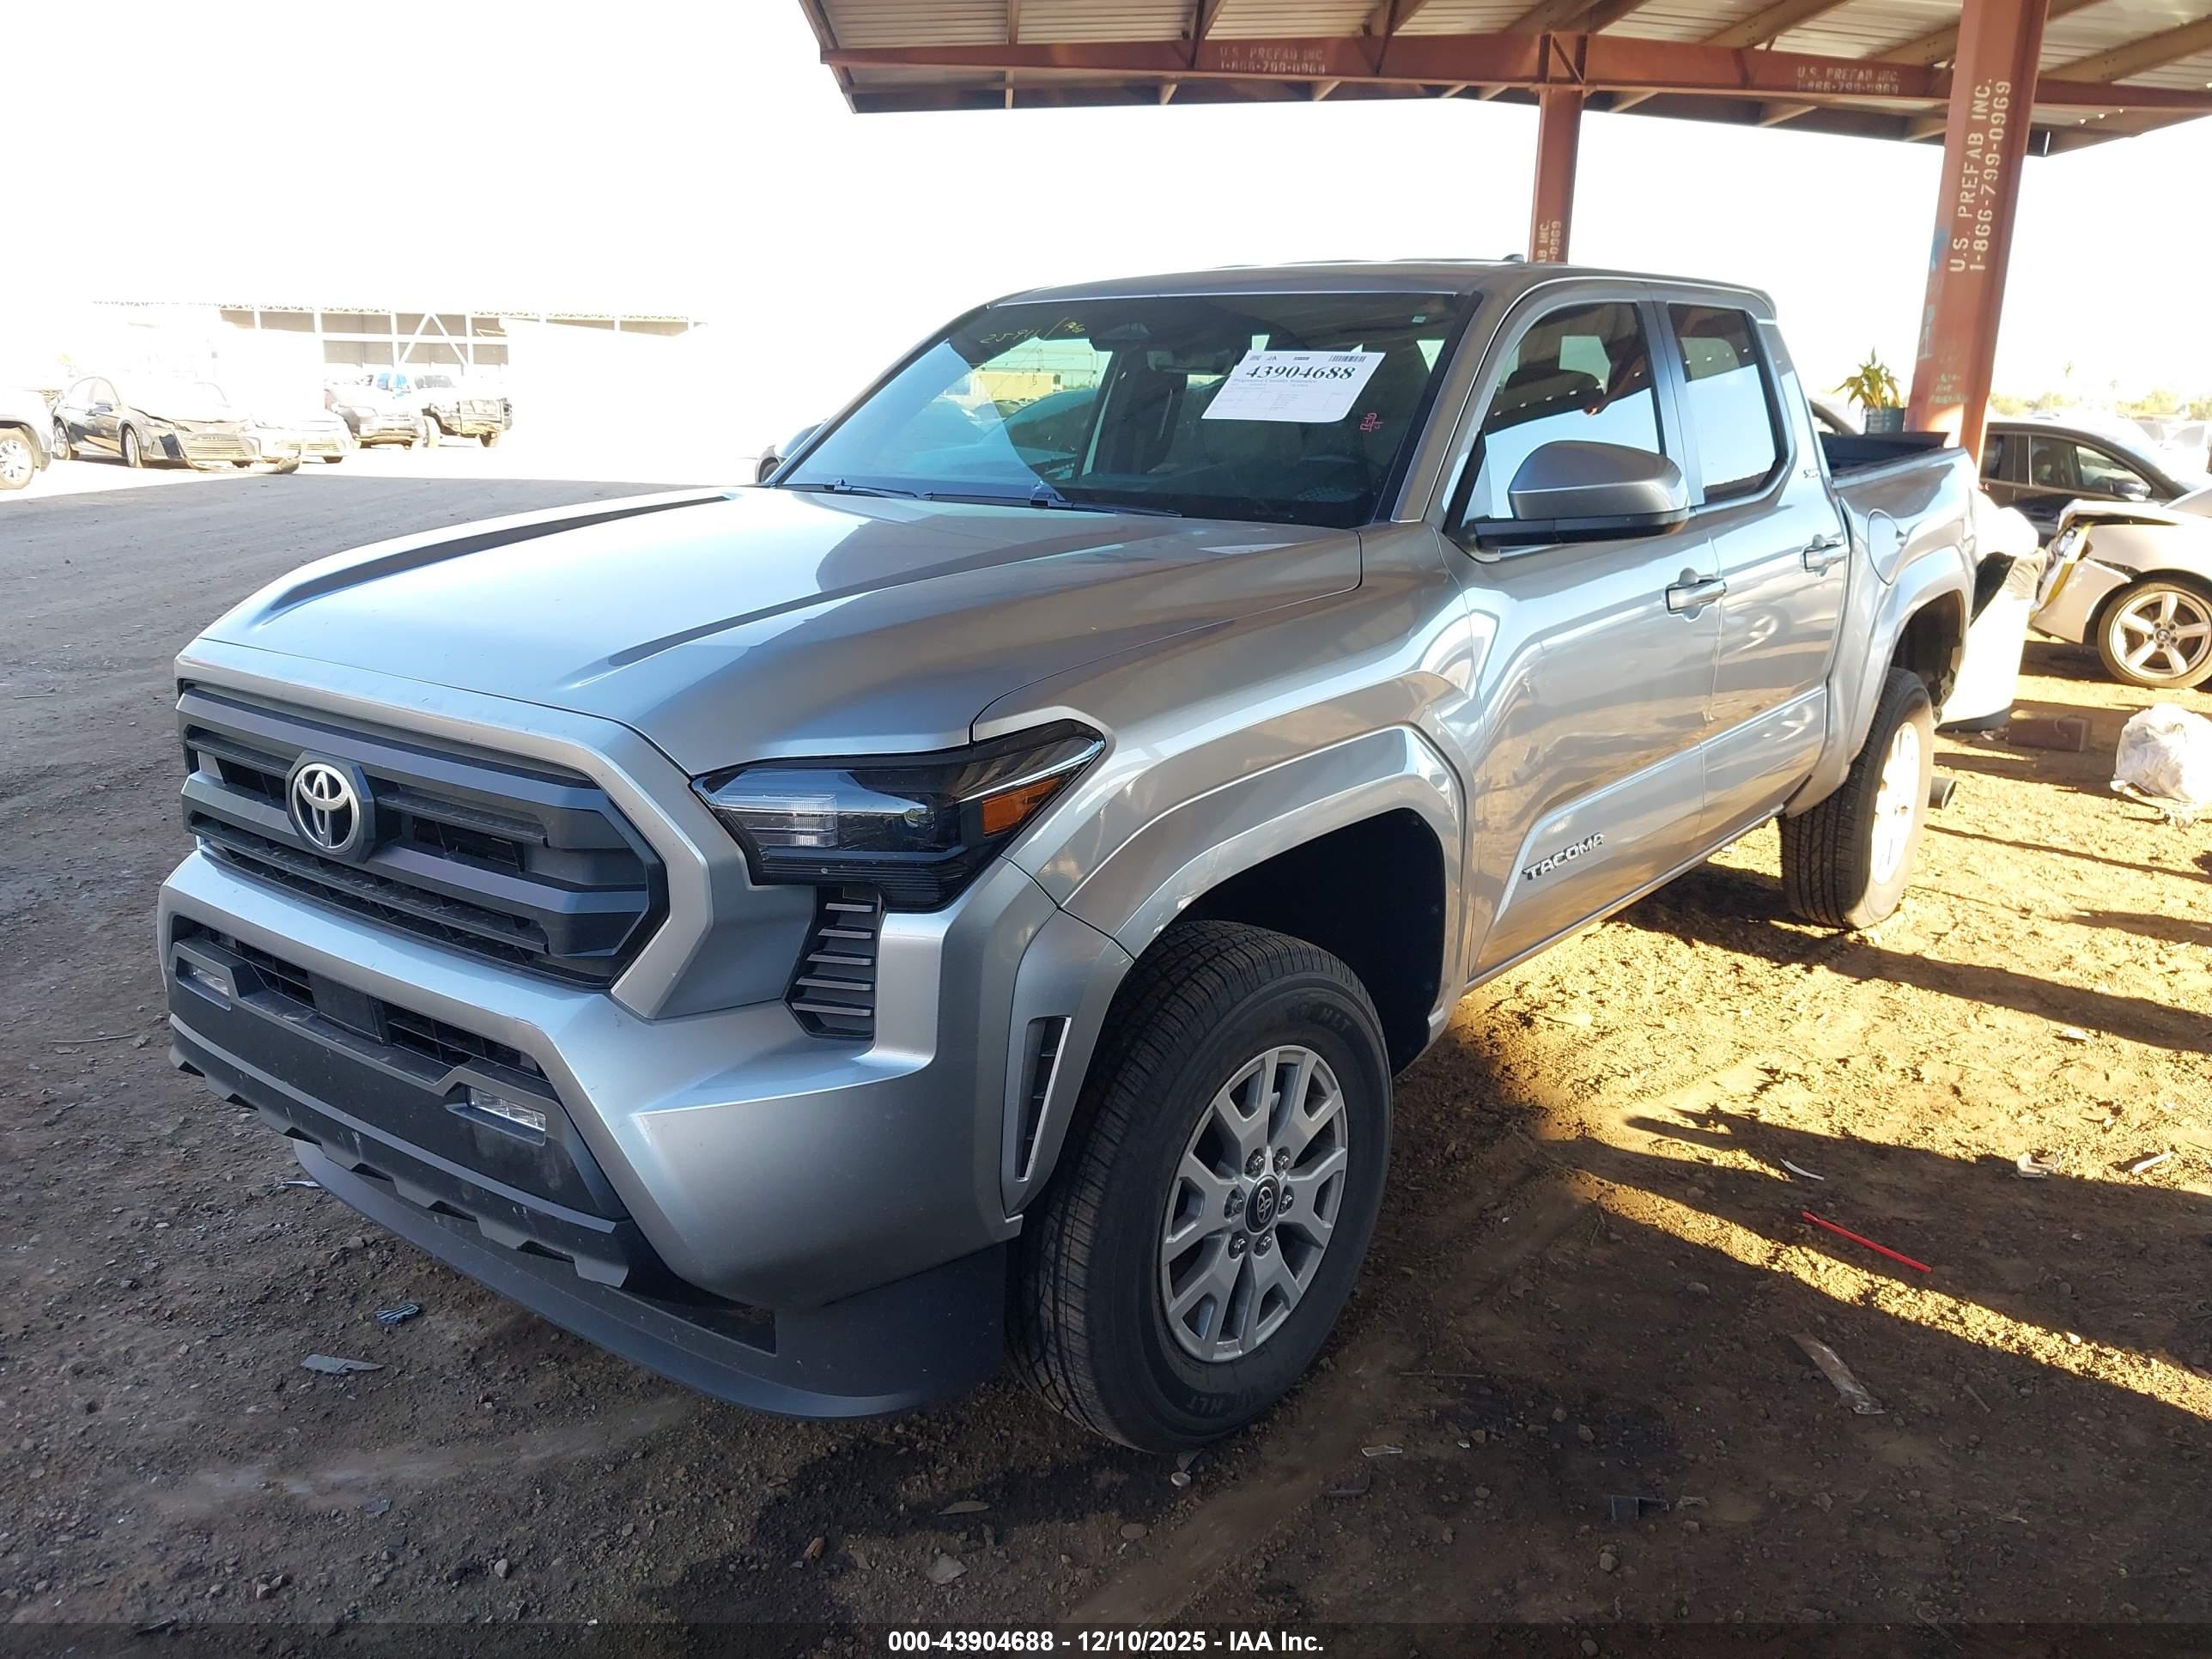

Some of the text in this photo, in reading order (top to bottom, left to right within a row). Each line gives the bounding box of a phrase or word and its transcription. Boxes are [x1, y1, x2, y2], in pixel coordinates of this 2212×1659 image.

[1948, 78, 1992, 272] U.S. PREFAB INC.
[1969, 81, 2012, 271] 1-866-799-0969
[1246, 365, 1356, 380] 43904688
[1522, 832, 1605, 880] TACOMA
